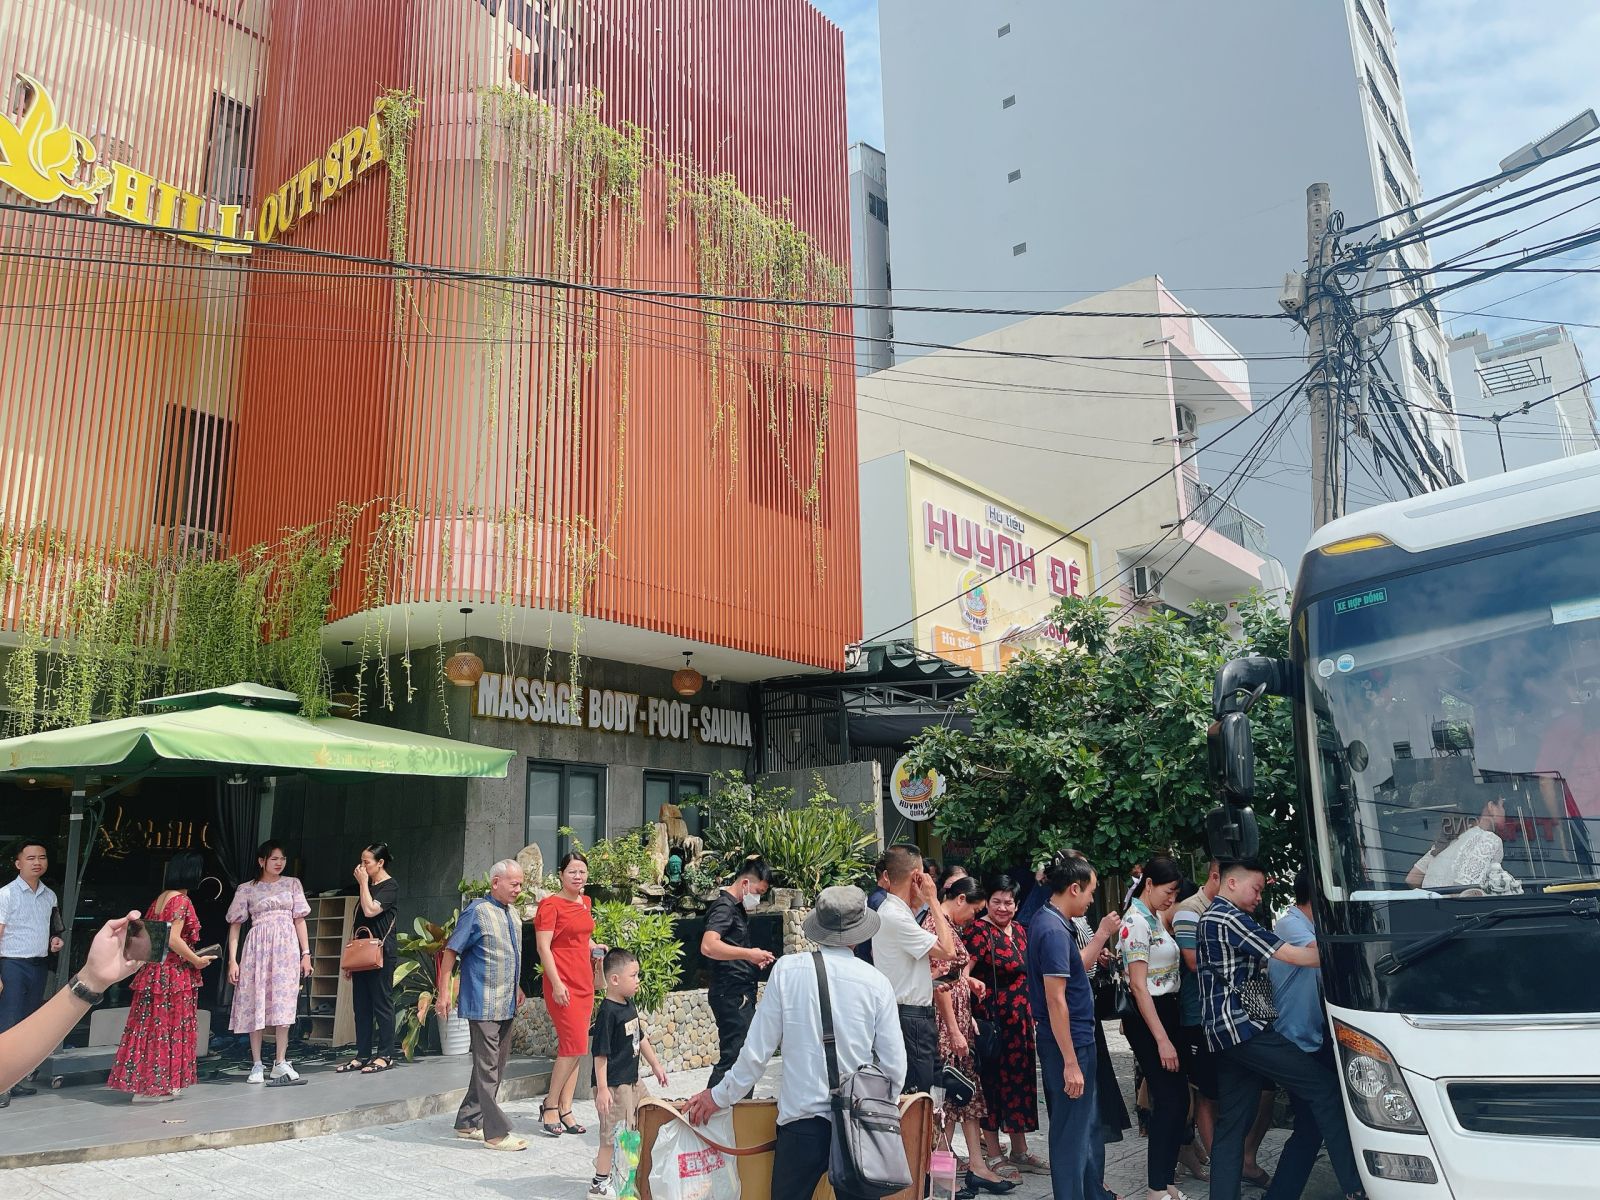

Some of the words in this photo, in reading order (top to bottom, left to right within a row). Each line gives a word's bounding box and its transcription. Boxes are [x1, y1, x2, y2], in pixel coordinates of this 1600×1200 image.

[259, 159, 320, 243] OUT
[322, 98, 384, 202] SPA
[1337, 601, 1347, 611] XE
[478, 673, 582, 727] MASSAGE
[588, 689, 639, 733] BODY
[649, 697, 691, 740] FOOT
[700, 705, 753, 748] SAUNA
